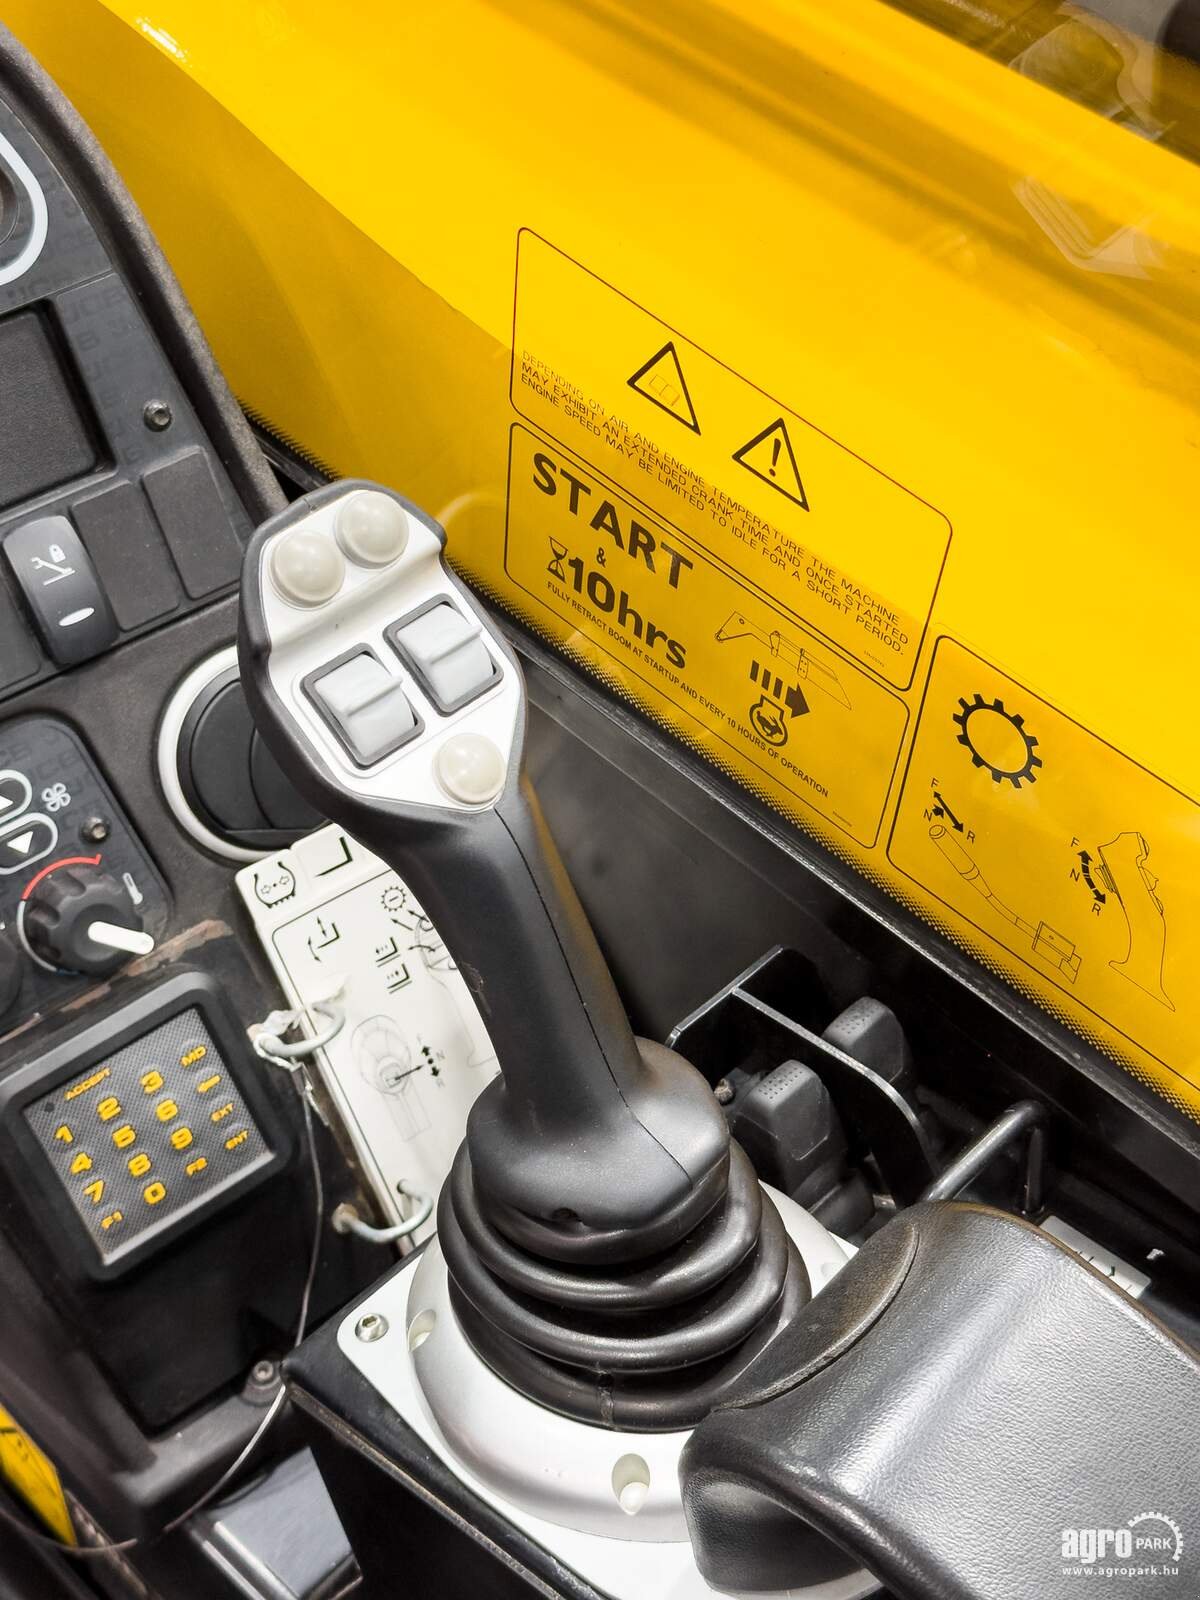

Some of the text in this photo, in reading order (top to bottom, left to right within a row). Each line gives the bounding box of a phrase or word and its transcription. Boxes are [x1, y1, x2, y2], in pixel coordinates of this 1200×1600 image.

[521, 361, 909, 646] MAY EXHIBIT AN EXTENDED CRANK TIME AND ONCE STARTED
[521, 373, 905, 656] ENGINE SPEED MAY BE LIMITED TO IDLE FOR A SHORT PERIOD.
[522, 350, 900, 626] DEPENDING ON AIR AND ENGINE TEMPERATURE THE MACHINE
[532, 452, 694, 590] START
[596, 546, 606, 568] &
[568, 556, 687, 670] 10hrs
[547, 580, 829, 798] FULLY RETRACT BOOM AT STARTUP AND EVERY 10 HOURS OF OPERATION
[930, 777, 941, 789] F
[923, 808, 933, 822] N
[966, 830, 977, 844] R
[1070, 837, 1081, 849] F
[1069, 868, 1081, 882] N
[1091, 902, 1102, 917] R
[54, 1046, 207, 1144] 1 2 3 MD
[64, 1066, 111, 1101] ACCEPT
[69, 1098, 179, 1176] 4 5 6
[83, 1179, 105, 1205] 7
[127, 1152, 152, 1178] 8
[170, 1126, 194, 1151] 9
[142, 1181, 167, 1206] 0
